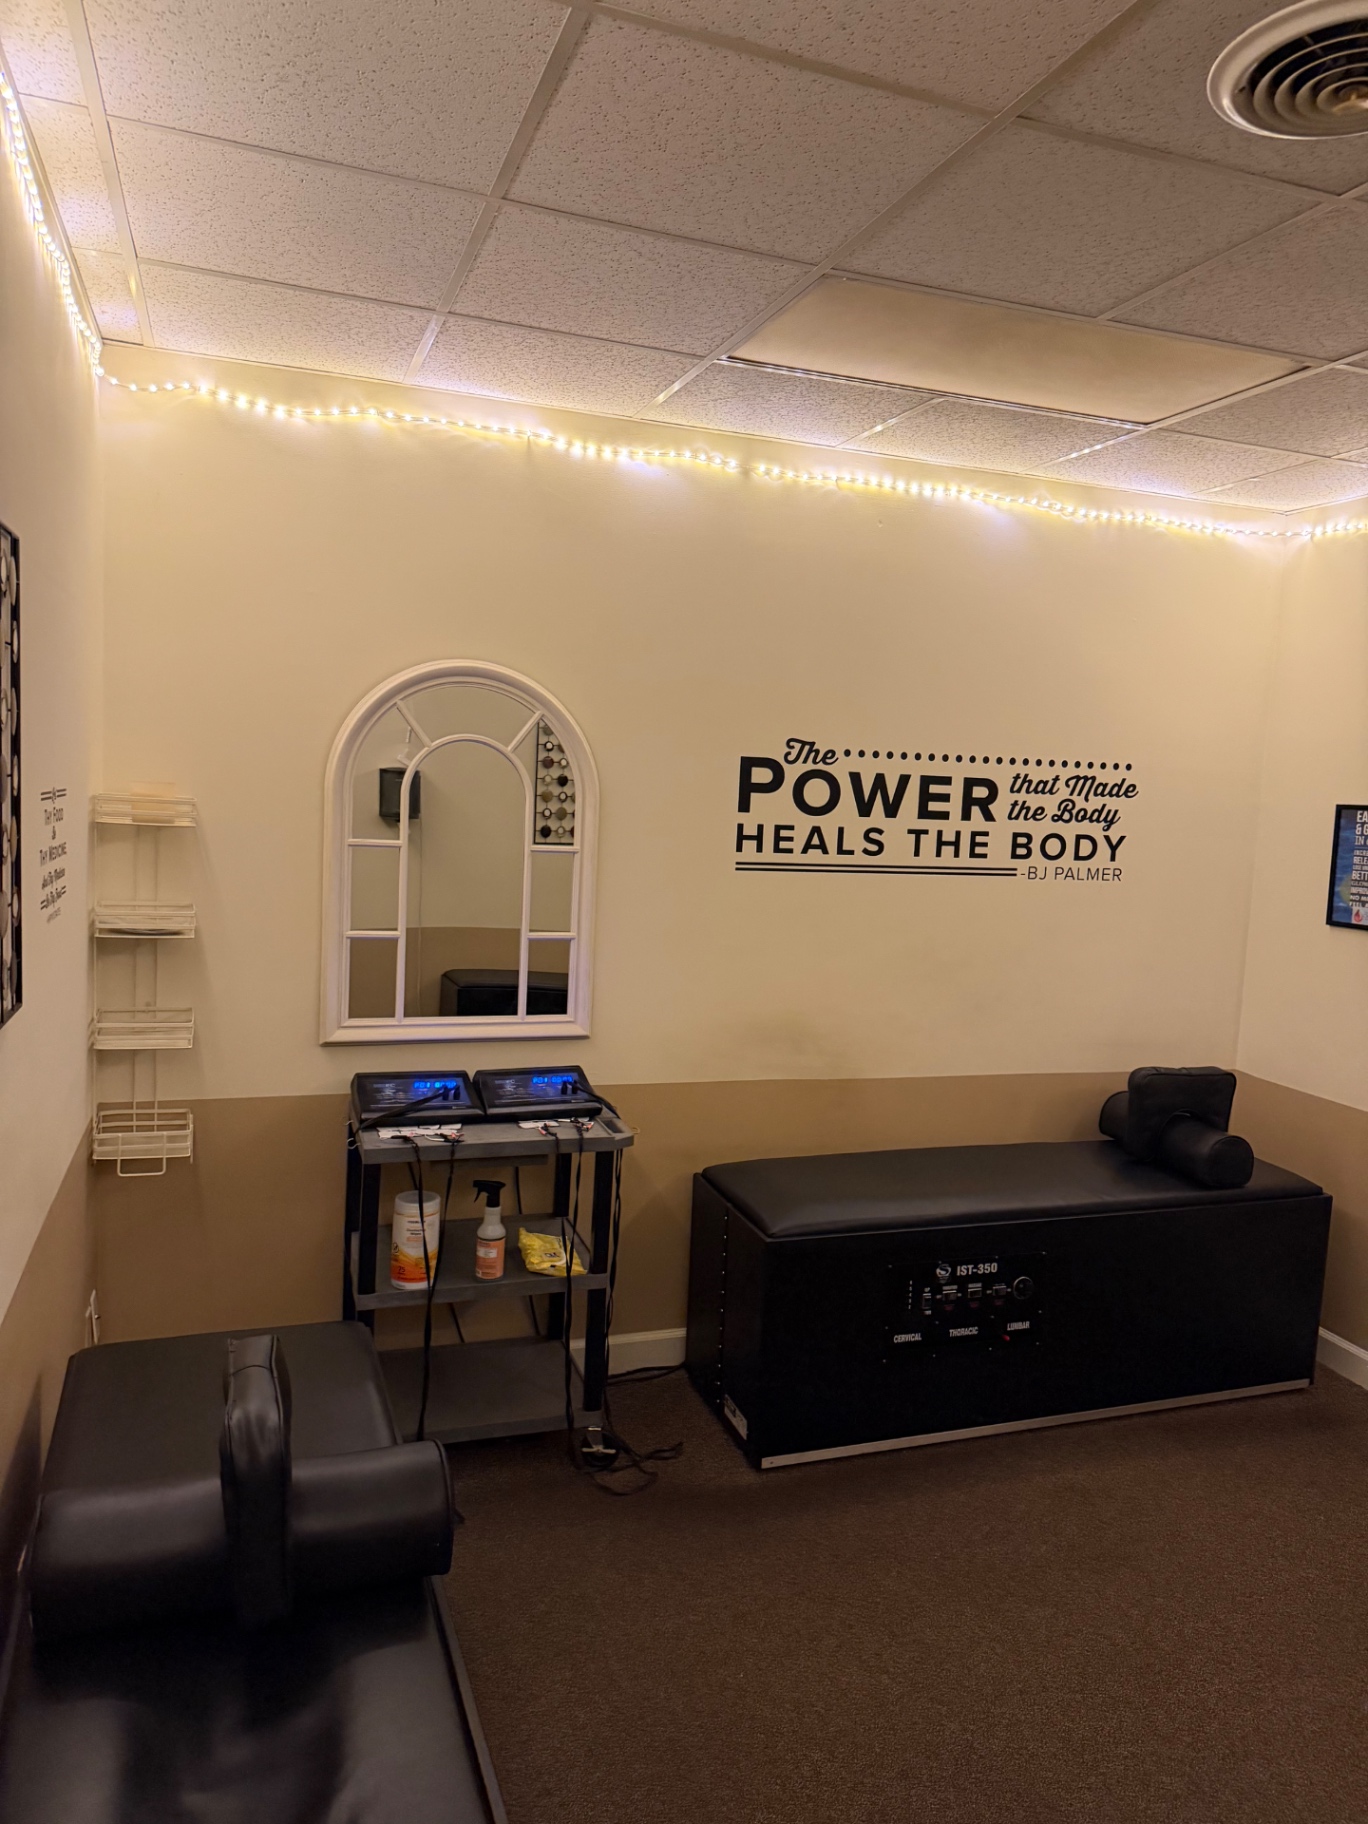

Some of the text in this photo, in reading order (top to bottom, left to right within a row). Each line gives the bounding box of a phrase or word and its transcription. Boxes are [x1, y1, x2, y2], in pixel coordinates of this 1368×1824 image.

[783, 737, 839, 766] The
[737, 756, 999, 823] POWER
[1009, 773, 1139, 802] that Made
[1007, 798, 1121, 832] the Body
[735, 823, 1127, 863] HEALS THE BODY
[1053, 866, 1123, 882] PALMER
[956, 1262, 998, 1277] IST-350
[948, 1326, 979, 1338] THORACIC
[1006, 1320, 1031, 1331] LUMBAR
[893, 1332, 922, 1344] CERVICAL
